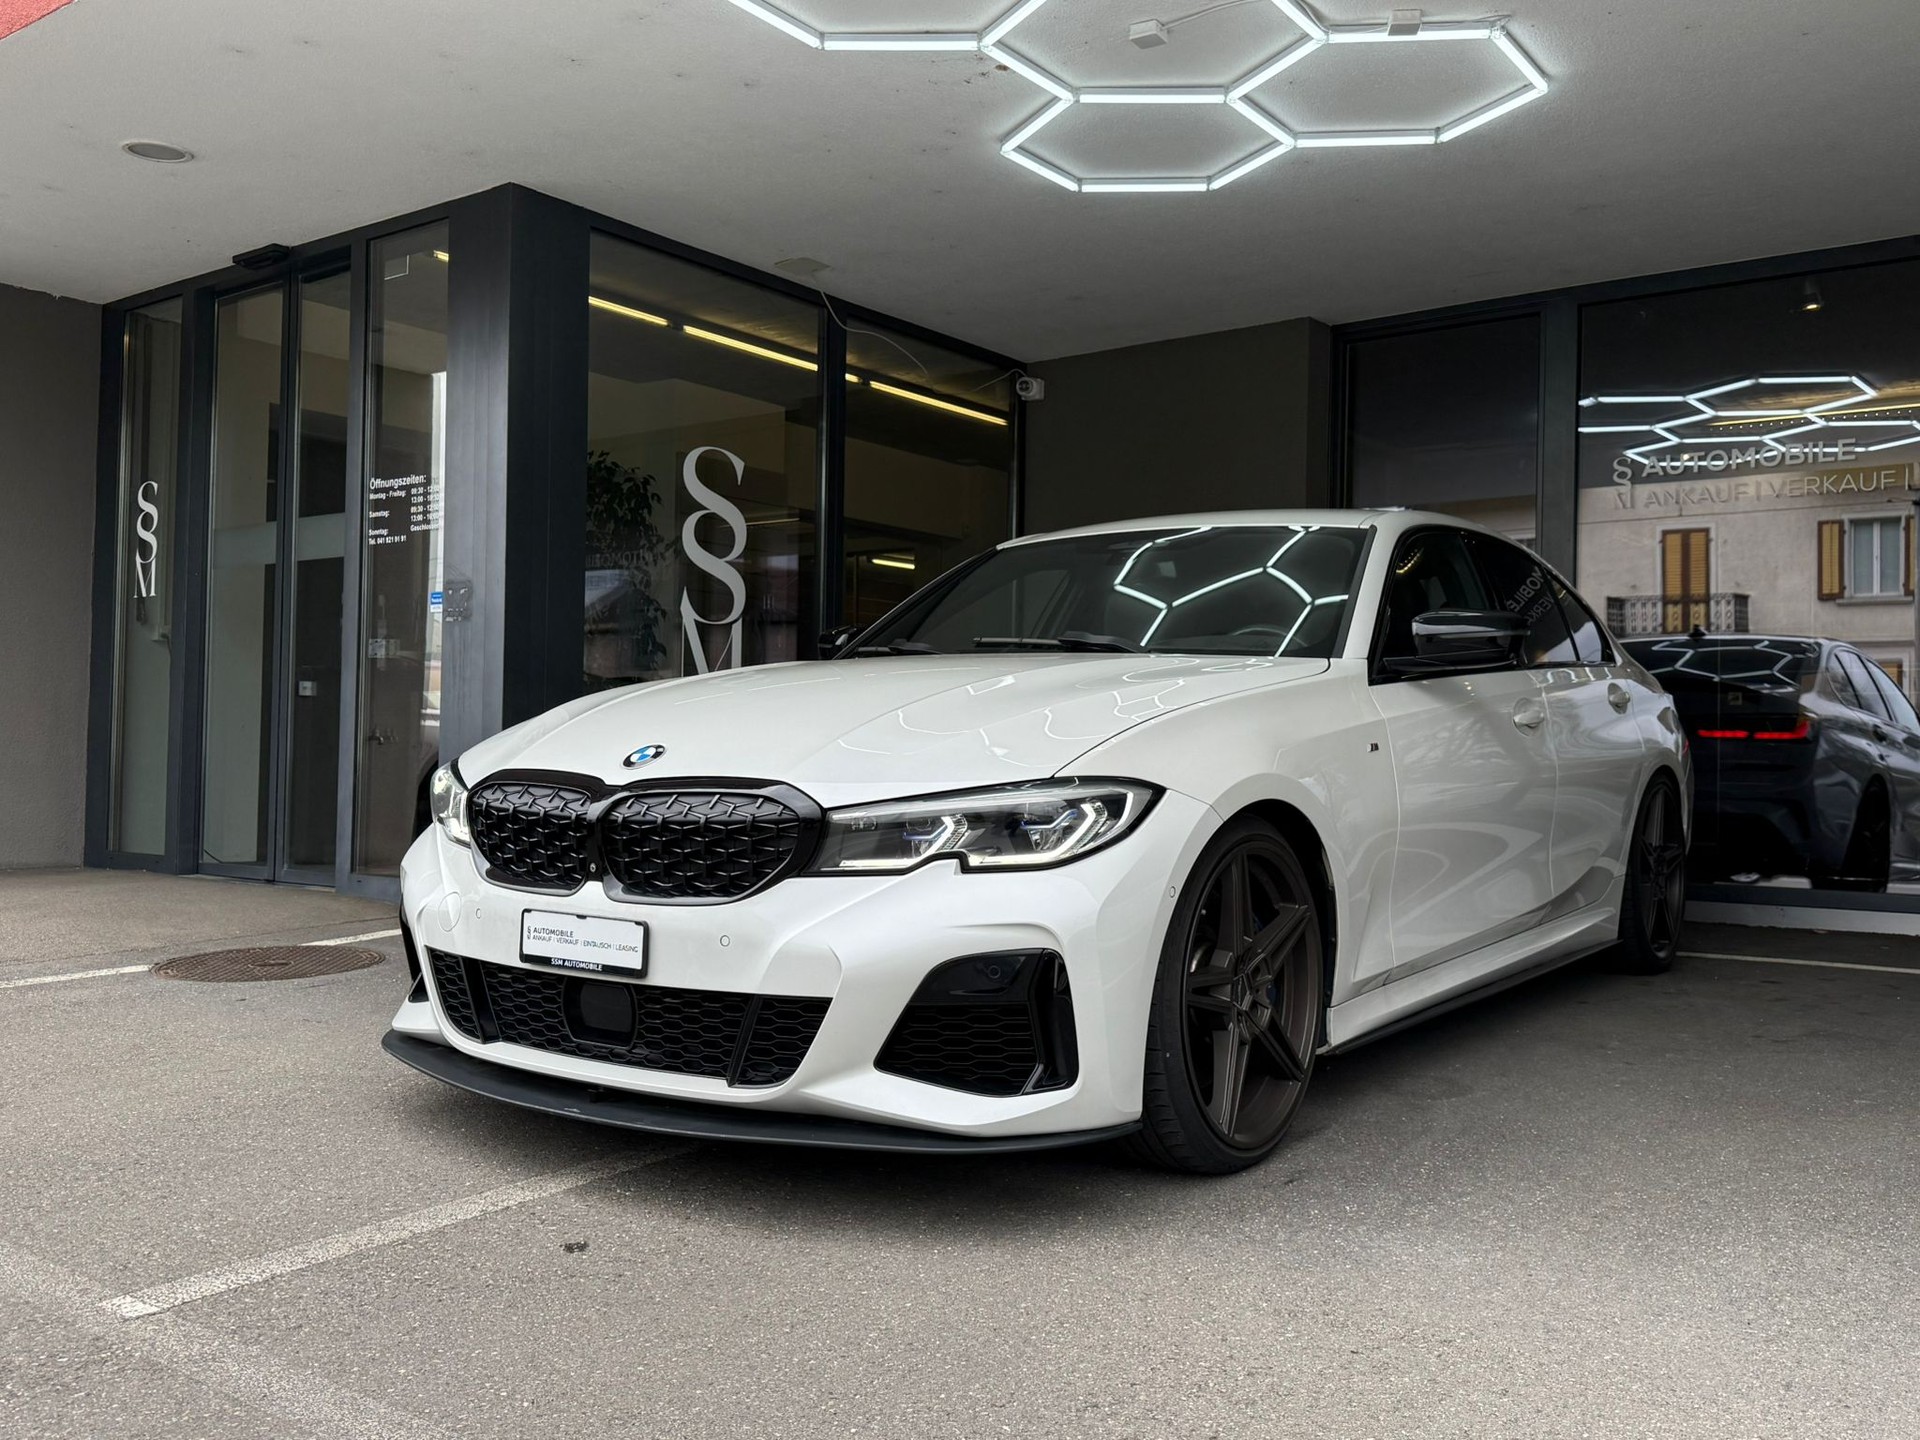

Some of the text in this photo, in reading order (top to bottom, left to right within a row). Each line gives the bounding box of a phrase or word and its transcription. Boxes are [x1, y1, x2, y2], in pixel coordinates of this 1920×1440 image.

[1641, 438, 1856, 478] AUTOMOBILE
[370, 475, 426, 489] Öffnungszeiten:
[1643, 482, 1750, 509] ANKAUF
[1766, 469, 1897, 499] VERKAUF
[369, 492, 386, 500] Montag
[389, 490, 407, 498] Freitag:
[133, 480, 159, 599] SSM
[368, 537, 376, 545] Tel.
[533, 927, 574, 938] AUTOMOBILE
[532, 934, 552, 942] ANKAUF
[556, 937, 580, 945] VERKAUF
[583, 940, 612, 949] EINTAUSCH
[615, 943, 639, 953] LEASING
[551, 958, 603, 971] SSM AUTOMOBILE
